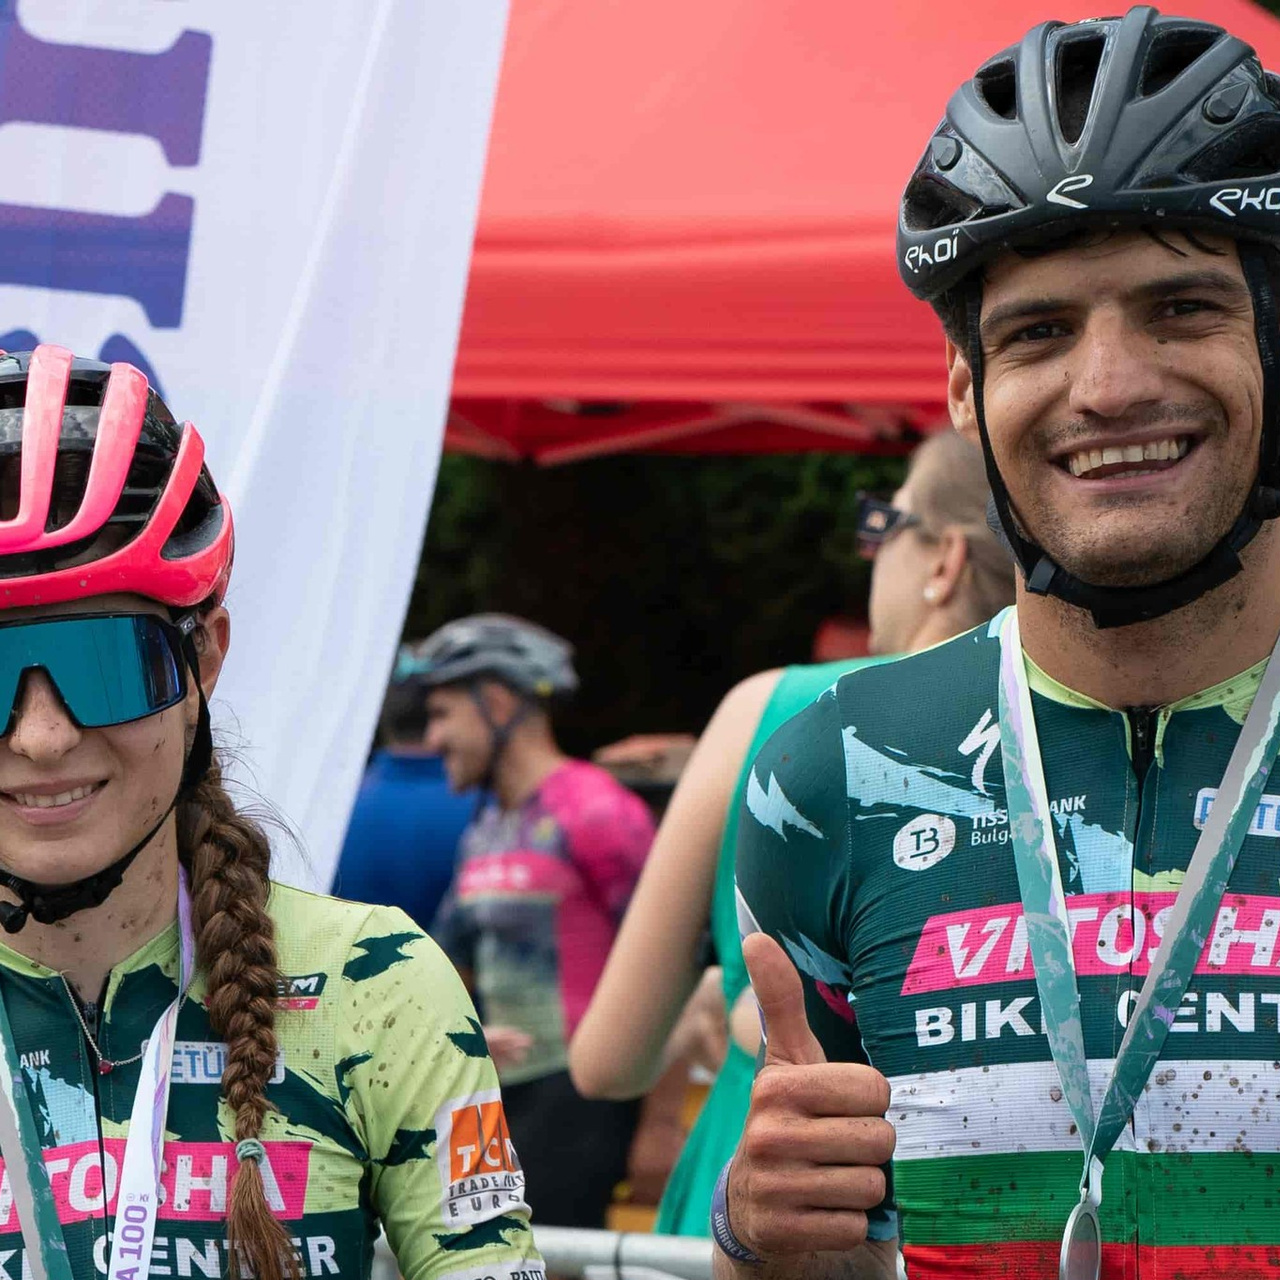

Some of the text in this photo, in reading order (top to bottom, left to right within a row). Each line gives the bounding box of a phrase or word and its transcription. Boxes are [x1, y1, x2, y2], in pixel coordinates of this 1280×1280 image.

[1049, 795, 1087, 815] ANK
[20, 1050, 52, 1069] ANK
[448, 1175, 499, 1198] TRADE
[119, 1204, 148, 1261] 100
